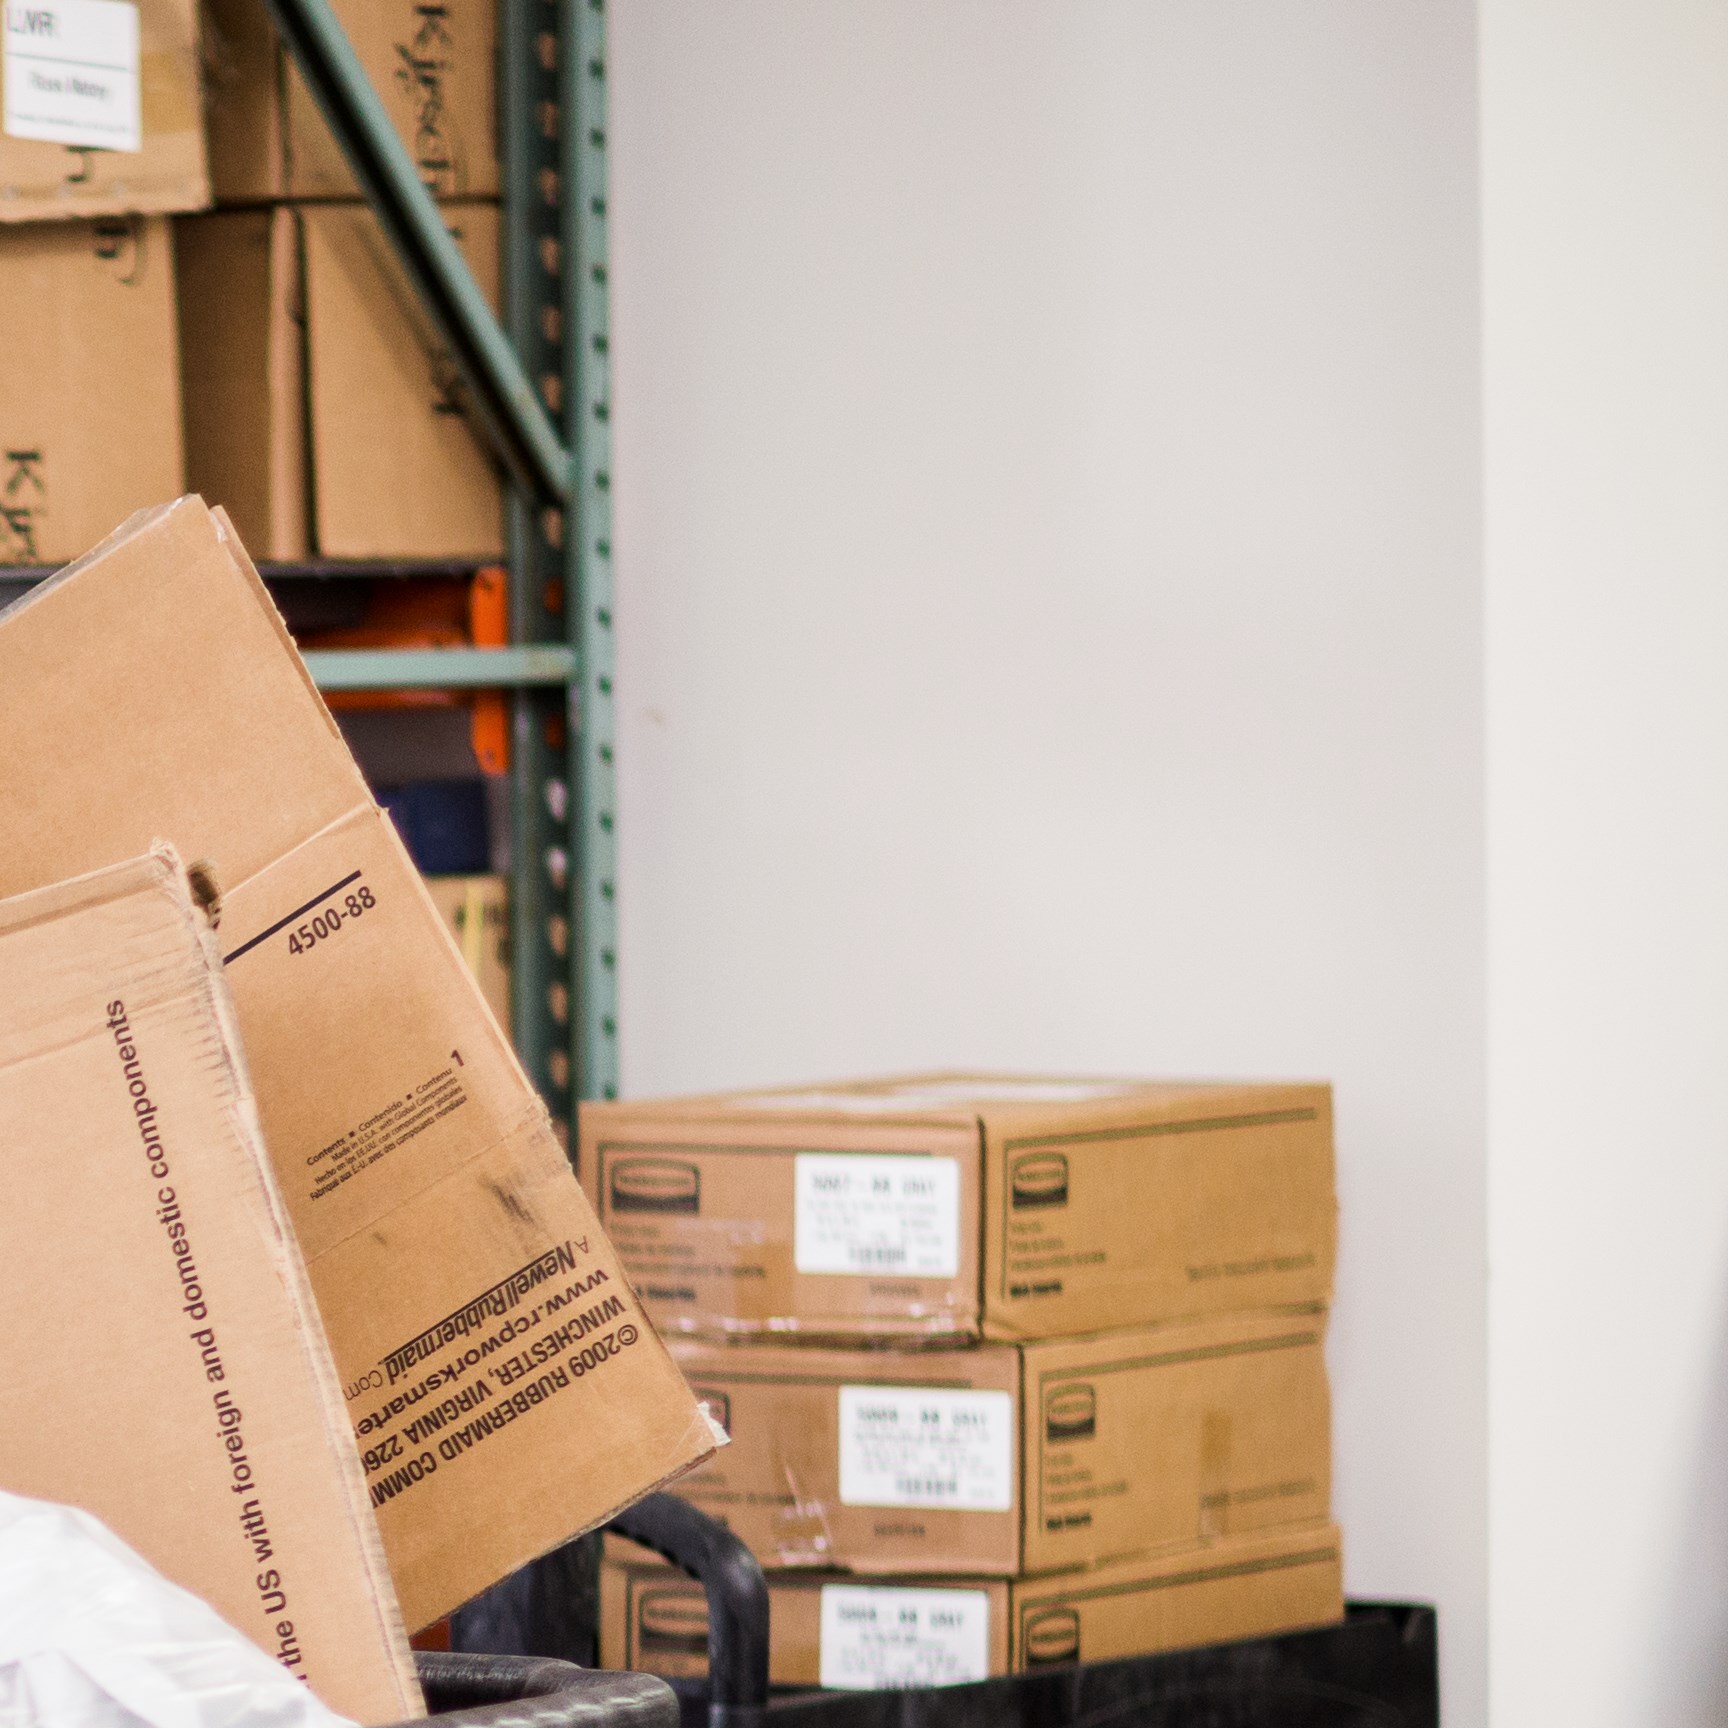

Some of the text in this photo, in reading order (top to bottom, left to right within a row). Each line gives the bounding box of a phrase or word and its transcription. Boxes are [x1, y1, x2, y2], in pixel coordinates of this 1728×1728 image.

[288, 886, 376, 955] 4500-88
[306, 1049, 465, 1166] Contents Contenido Contenu 1
[331, 1145, 352, 1162] Made
[350, 1140, 359, 1151] in
[378, 1117, 396, 1132] with
[393, 1101, 418, 1122] Global
[415, 1076, 458, 1108] Components
[575, 1234, 591, 1255] A
[106, 999, 302, 1668] the US with foreign and domestic components
[487, 1294, 627, 1387] WINCHESTER,
[401, 1378, 494, 1446] VIRGINIA
[438, 1366, 571, 1461] RUBBERMAID
